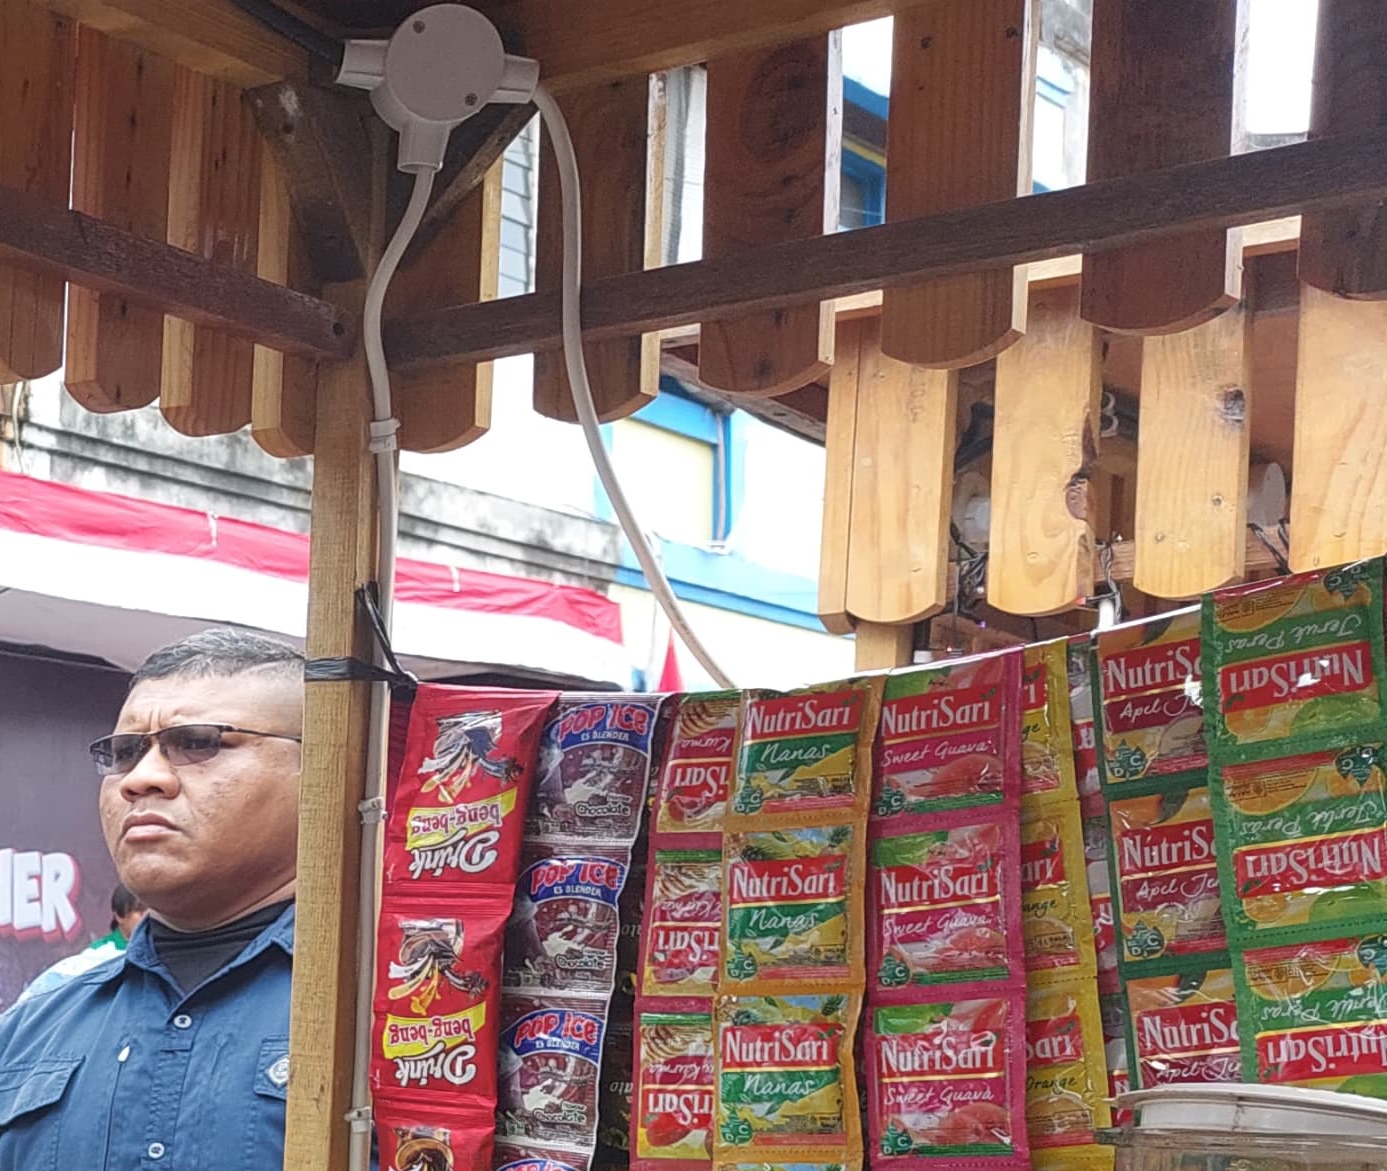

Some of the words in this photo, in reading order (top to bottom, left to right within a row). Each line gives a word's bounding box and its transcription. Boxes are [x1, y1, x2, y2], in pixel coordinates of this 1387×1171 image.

[1230, 649, 1365, 698] NutriSari
[557, 705, 606, 742] POP
[608, 704, 649, 736] ICE
[748, 700, 850, 732] NutriSari
[880, 696, 991, 736] NutriSari
[761, 742, 831, 764] Nanas
[881, 746, 930, 767] Sweet
[934, 739, 988, 759] Guava
[674, 765, 729, 797] iSari
[411, 802, 503, 834] beng-beng
[576, 802, 632, 816] Chocolate
[408, 827, 500, 880] Drink
[1244, 838, 1381, 884] NutriSari
[530, 861, 577, 895] POP
[580, 861, 620, 890] ICE
[732, 864, 836, 900] NutriSari
[880, 864, 988, 904] NutriSari
[749, 908, 819, 931] Nanas
[883, 917, 932, 936] Sweet
[937, 911, 988, 933] Guava
[657, 930, 720, 962] riSari
[388, 1016, 474, 1045] beng-beng
[514, 1012, 560, 1048] POP
[562, 1012, 598, 1046] ICE
[726, 1029, 828, 1063] NutriSari
[395, 1041, 476, 1087] Drink
[880, 1036, 995, 1073] NutriSari
[1266, 1034, 1387, 1073] utriSari
[743, 1073, 815, 1096] Nanas
[884, 1087, 934, 1105] Sweet
[939, 1086, 995, 1102] Guava
[647, 1092, 712, 1125] riSari
